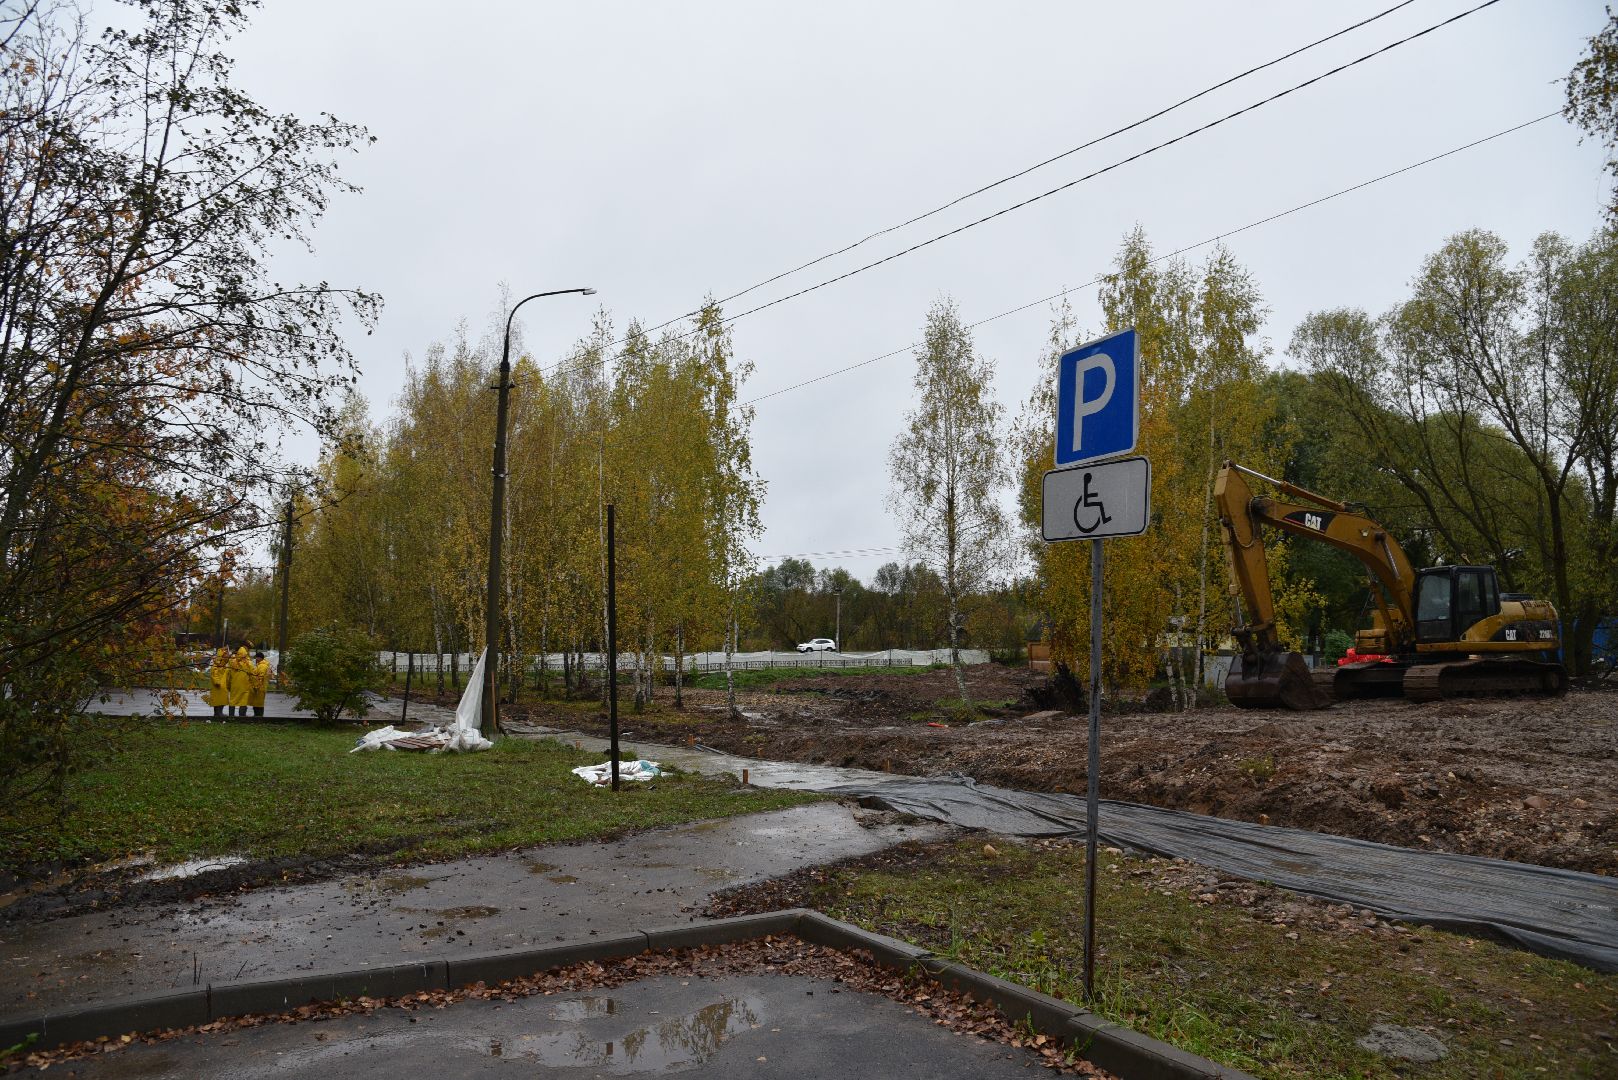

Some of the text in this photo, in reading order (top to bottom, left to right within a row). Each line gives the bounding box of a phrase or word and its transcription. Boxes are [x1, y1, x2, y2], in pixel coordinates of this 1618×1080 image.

[1072, 353, 1117, 452] P
[1304, 512, 1322, 531] CAT
[1505, 629, 1517, 641] CAT
